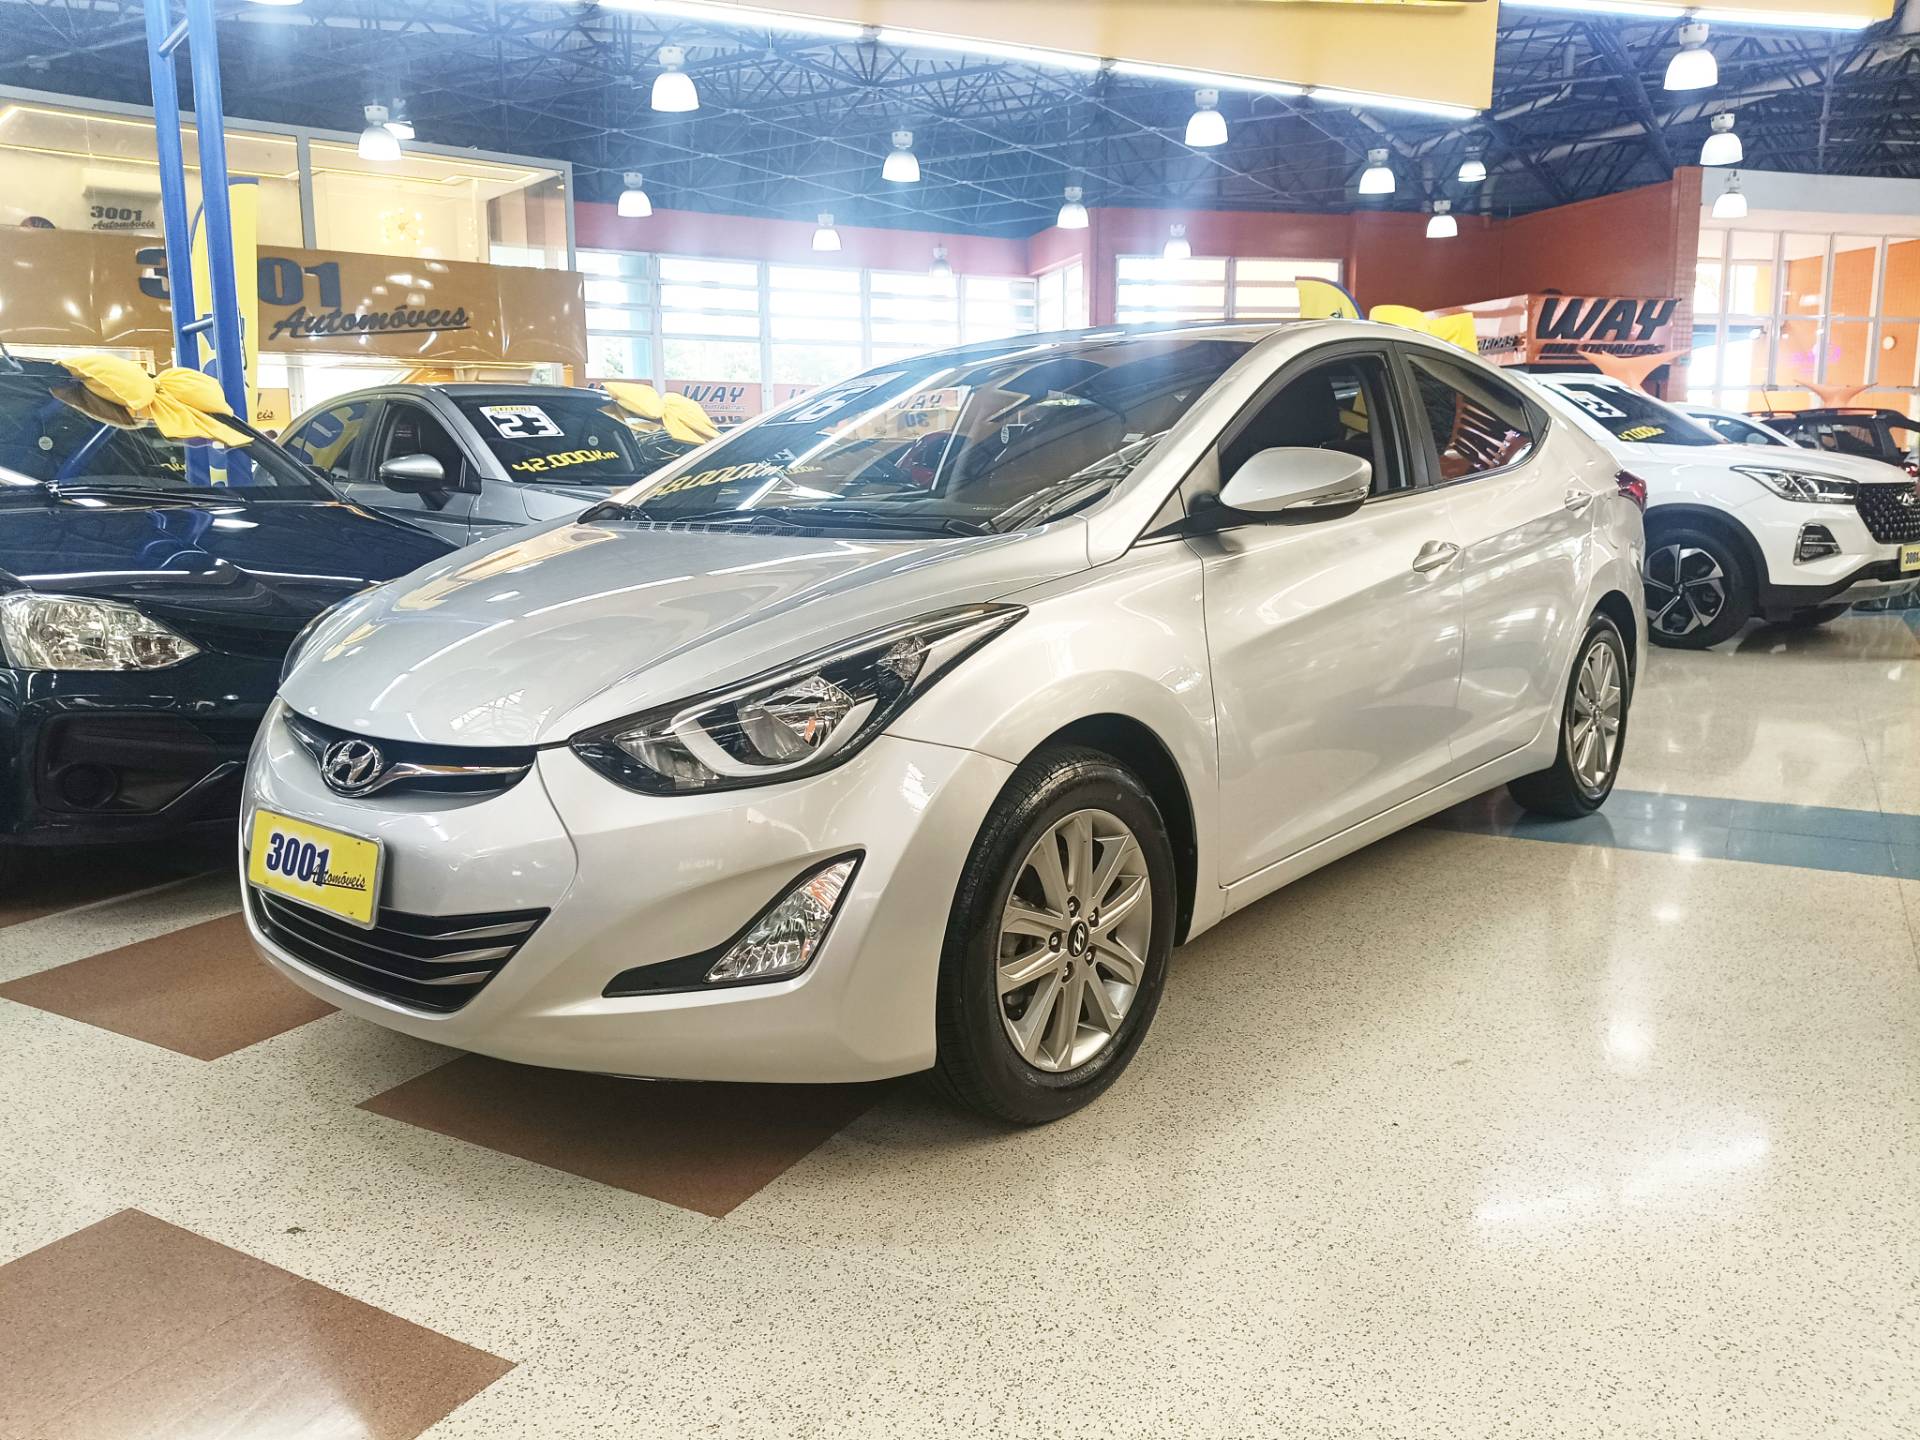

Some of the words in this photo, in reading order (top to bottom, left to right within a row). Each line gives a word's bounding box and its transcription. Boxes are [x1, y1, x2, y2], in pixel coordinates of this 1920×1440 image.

[90, 205, 143, 221] 3001
[136, 247, 341, 308] 301
[268, 304, 471, 341] Automóveis
[1536, 298, 1679, 341] WAY
[682, 385, 745, 403] WAY
[496, 413, 560, 437] 23
[266, 832, 330, 887] 3001
